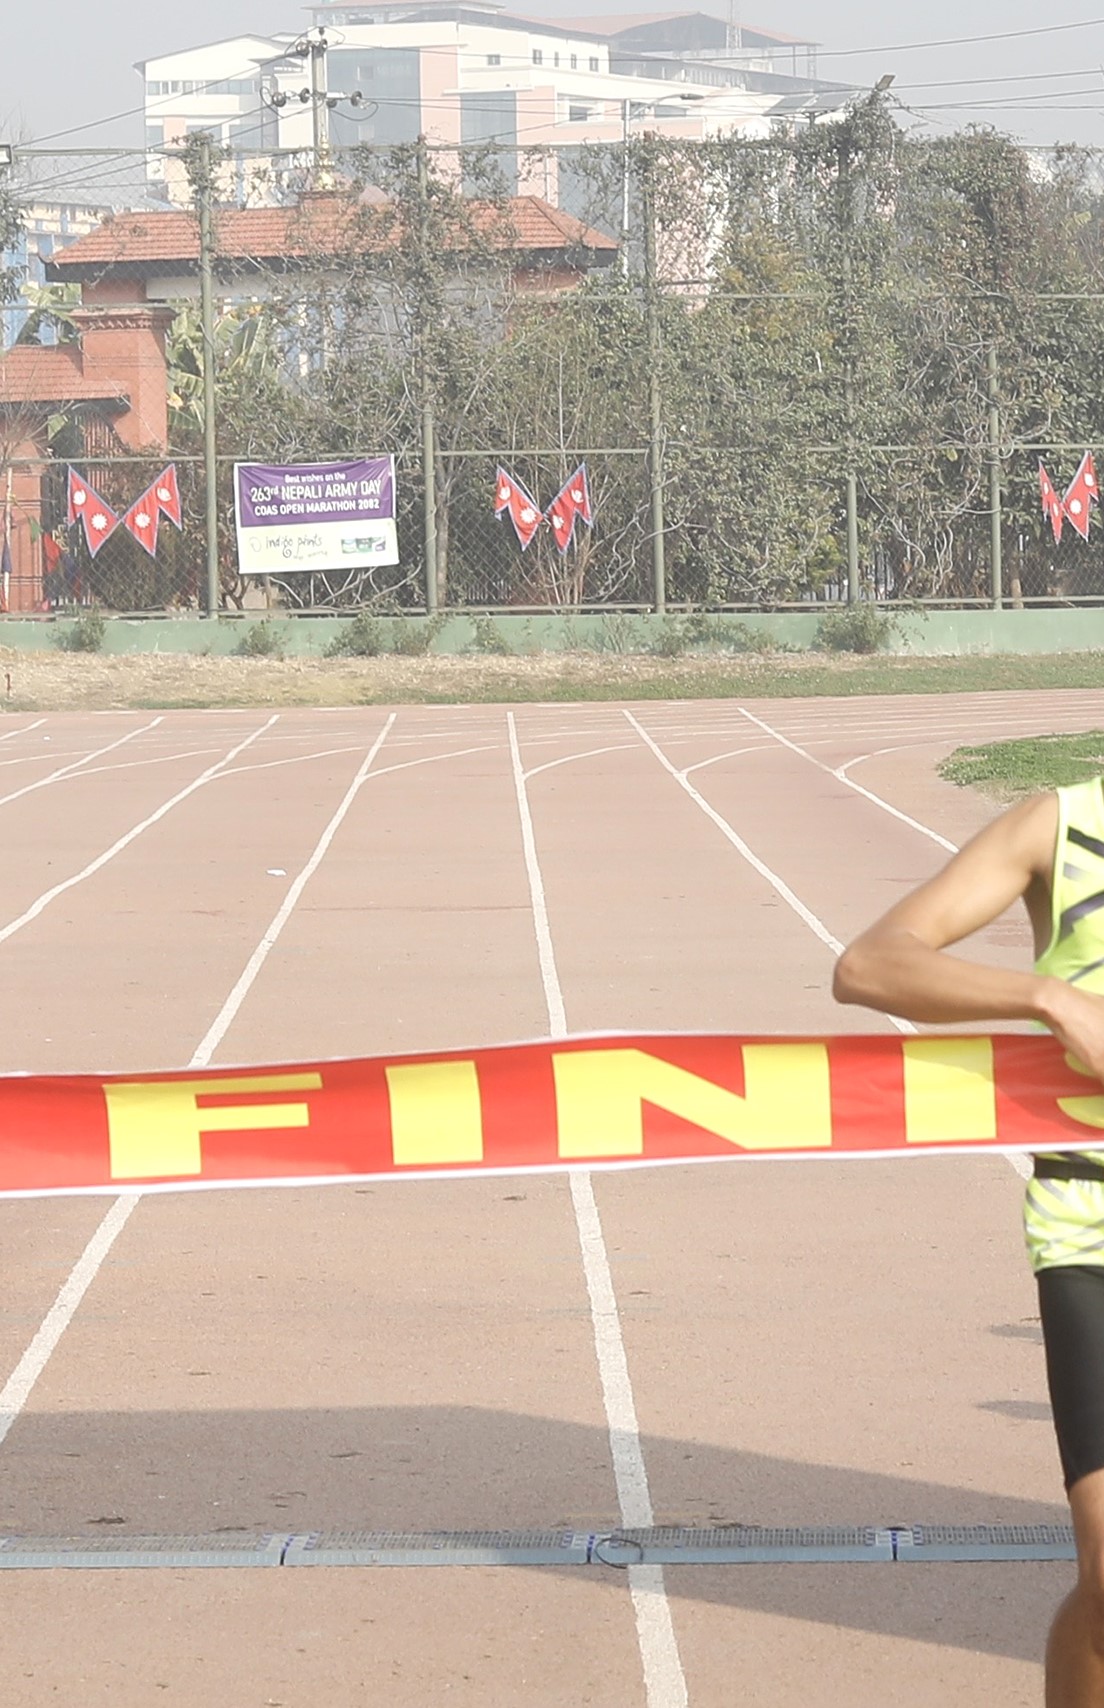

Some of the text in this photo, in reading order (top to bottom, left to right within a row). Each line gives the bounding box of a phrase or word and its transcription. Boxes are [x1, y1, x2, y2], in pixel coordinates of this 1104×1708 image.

[285, 472, 346, 484] Best wishes on the
[251, 479, 382, 502] 263rd NEPALI ARMY DAY
[254, 498, 380, 516] COAS OPEN MARATHON 2082
